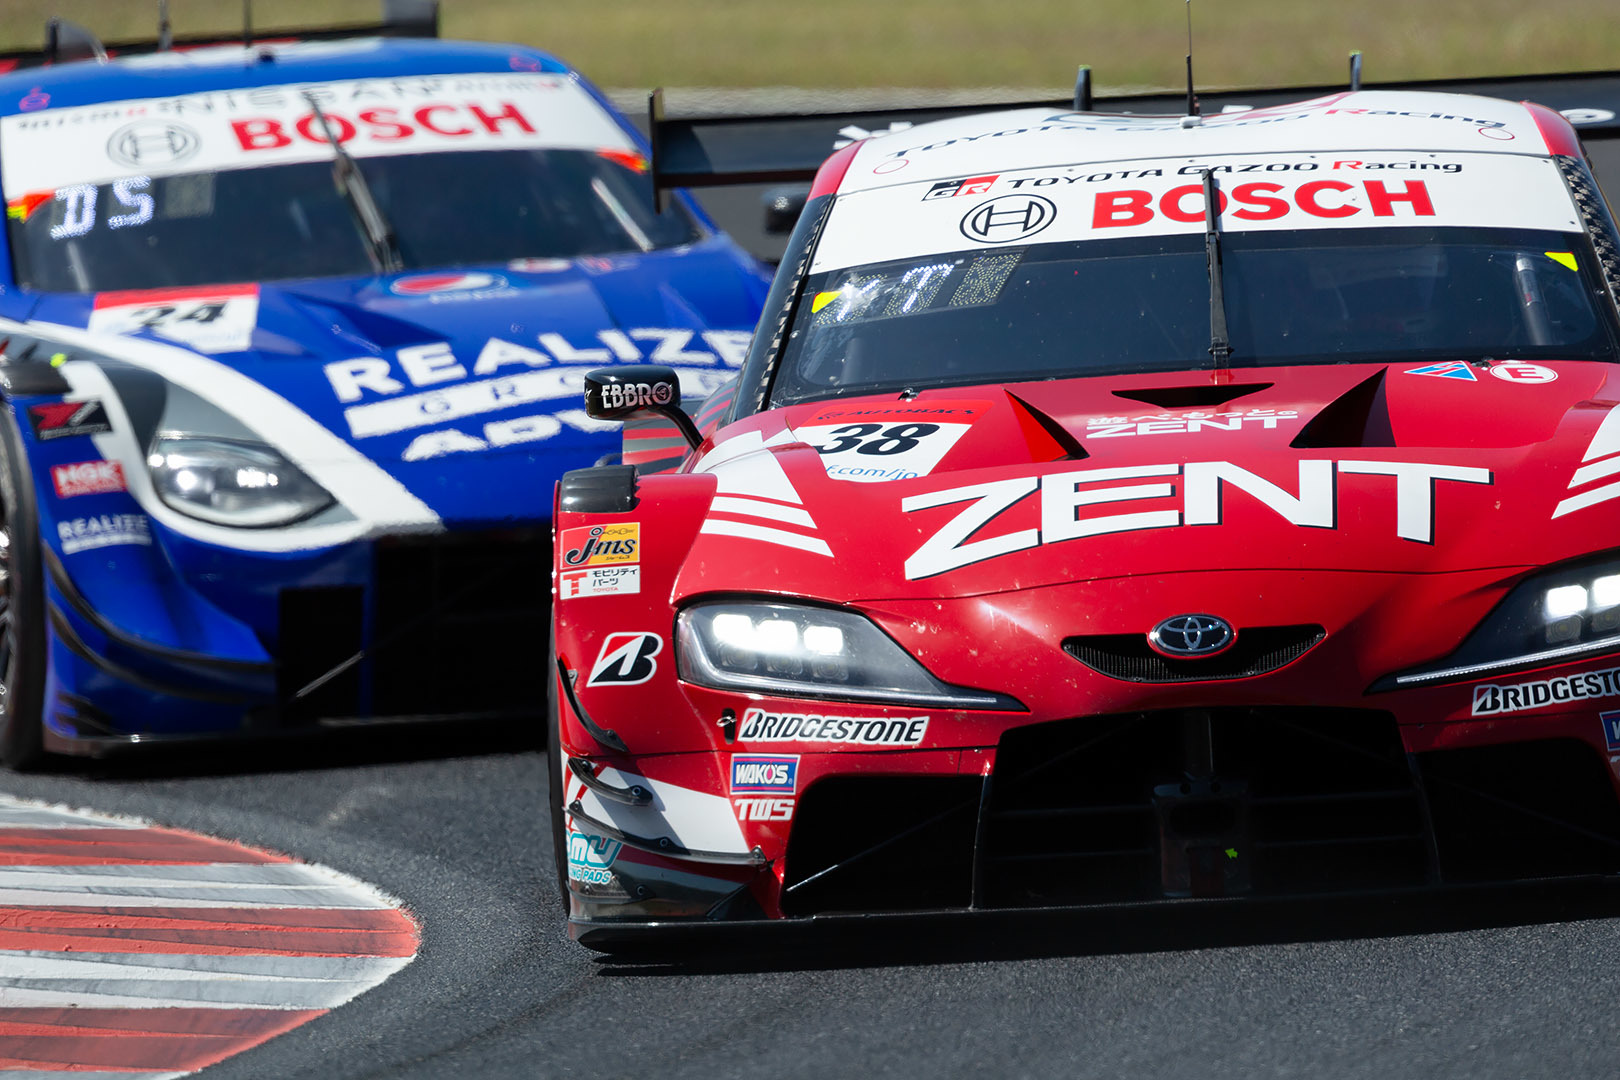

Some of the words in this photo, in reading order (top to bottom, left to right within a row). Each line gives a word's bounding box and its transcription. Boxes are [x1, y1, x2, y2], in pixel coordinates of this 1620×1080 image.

[229, 102, 539, 152] BOSCH
[886, 124, 1096, 158] TOYOTA
[1325, 108, 1506, 129] Racing
[1007, 168, 1164, 189] TOYOTA
[1177, 164, 1319, 177] GAZOO
[1332, 159, 1464, 175] Racing
[1090, 179, 1437, 230] BOSCH
[323, 327, 756, 403] REALIZE
[600, 381, 673, 409] EBBRO
[812, 422, 941, 456] 38
[1085, 415, 1299, 439] ZENT
[902, 458, 1493, 580] ZENT
[564, 526, 638, 566] jms
[592, 567, 638, 578] モビリティ
[592, 577, 619, 588] パーツ
[740, 709, 926, 743] BRIDGESTONE
[733, 798, 796, 822] TWS
[582, 869, 612, 884] PADS
